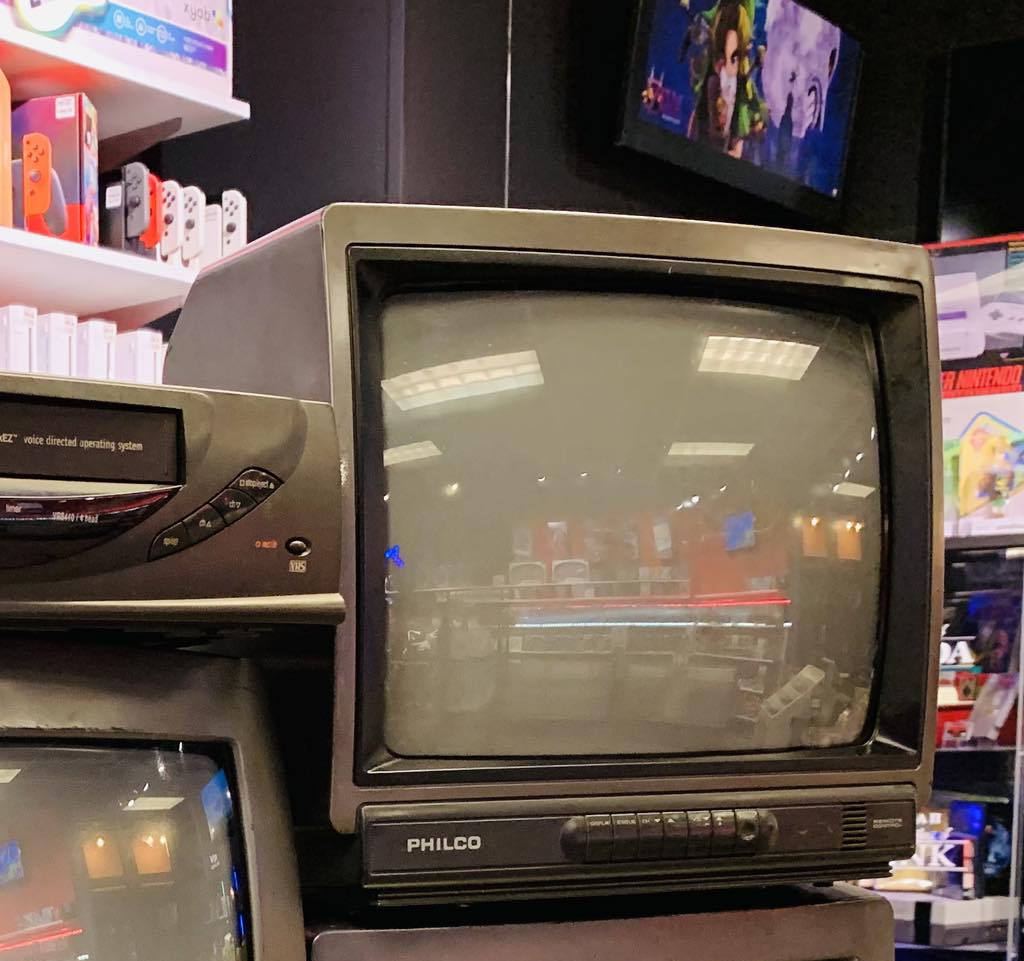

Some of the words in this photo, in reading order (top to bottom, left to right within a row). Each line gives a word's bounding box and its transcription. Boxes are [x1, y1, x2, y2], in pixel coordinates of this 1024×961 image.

[958, 365, 1022, 390] NINTENDO
[23, 434, 44, 446] voice
[45, 434, 77, 447] directed
[79, 437, 116, 452] operating
[117, 440, 144, 453] system
[5, 503, 22, 514] timer
[290, 561, 306, 572] VHS
[407, 836, 482, 853] PHILCO
